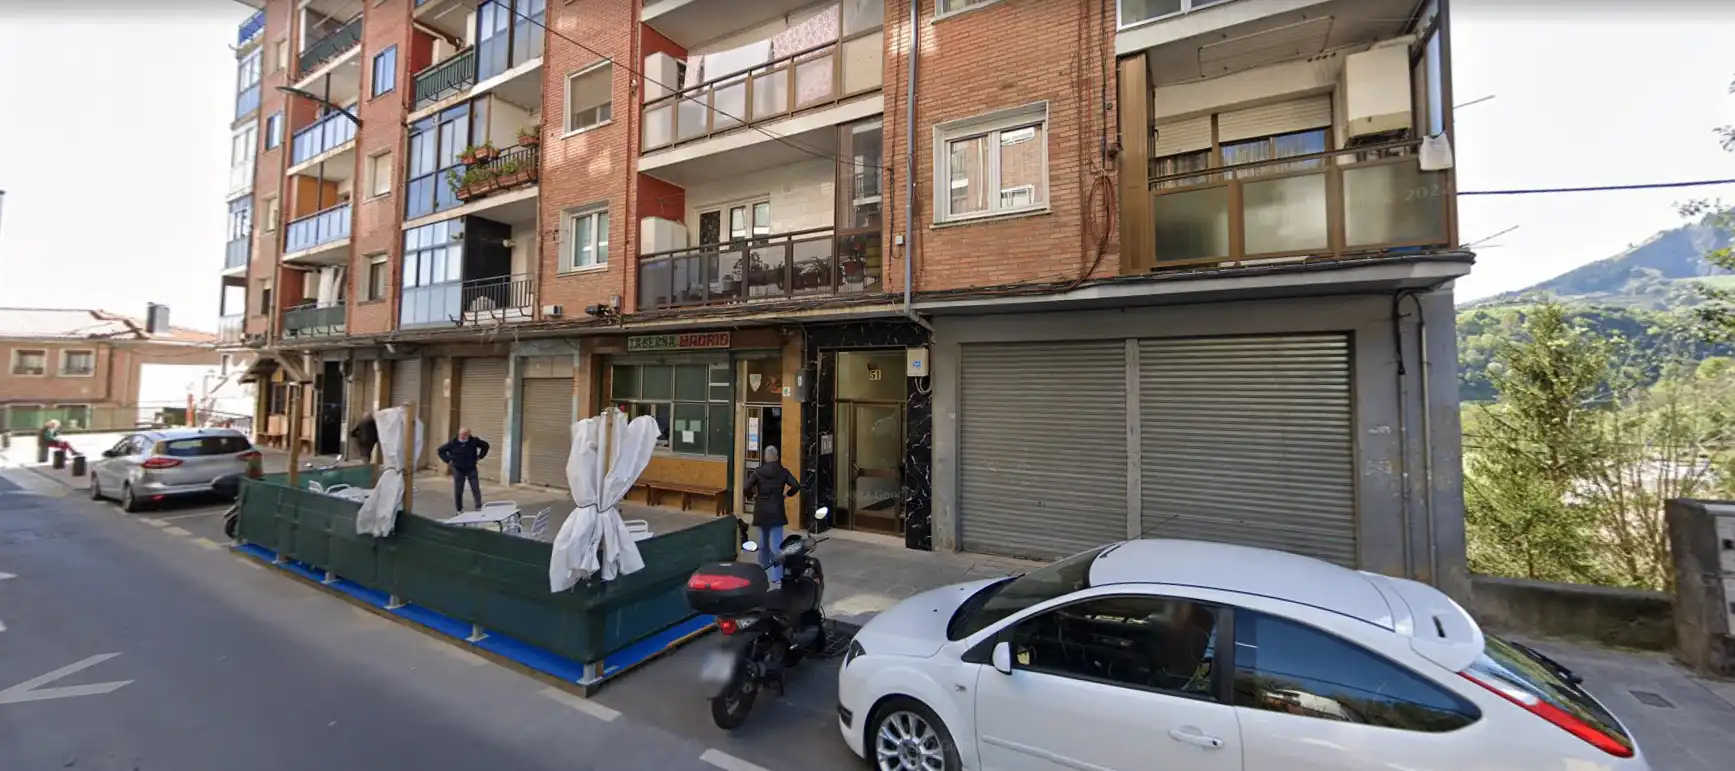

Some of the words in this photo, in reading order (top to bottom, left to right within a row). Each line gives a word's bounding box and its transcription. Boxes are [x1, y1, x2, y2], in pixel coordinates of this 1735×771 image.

[629, 336, 678, 349] TABERNA
[680, 333, 728, 348] MADRID
[870, 370, 880, 379] 51
